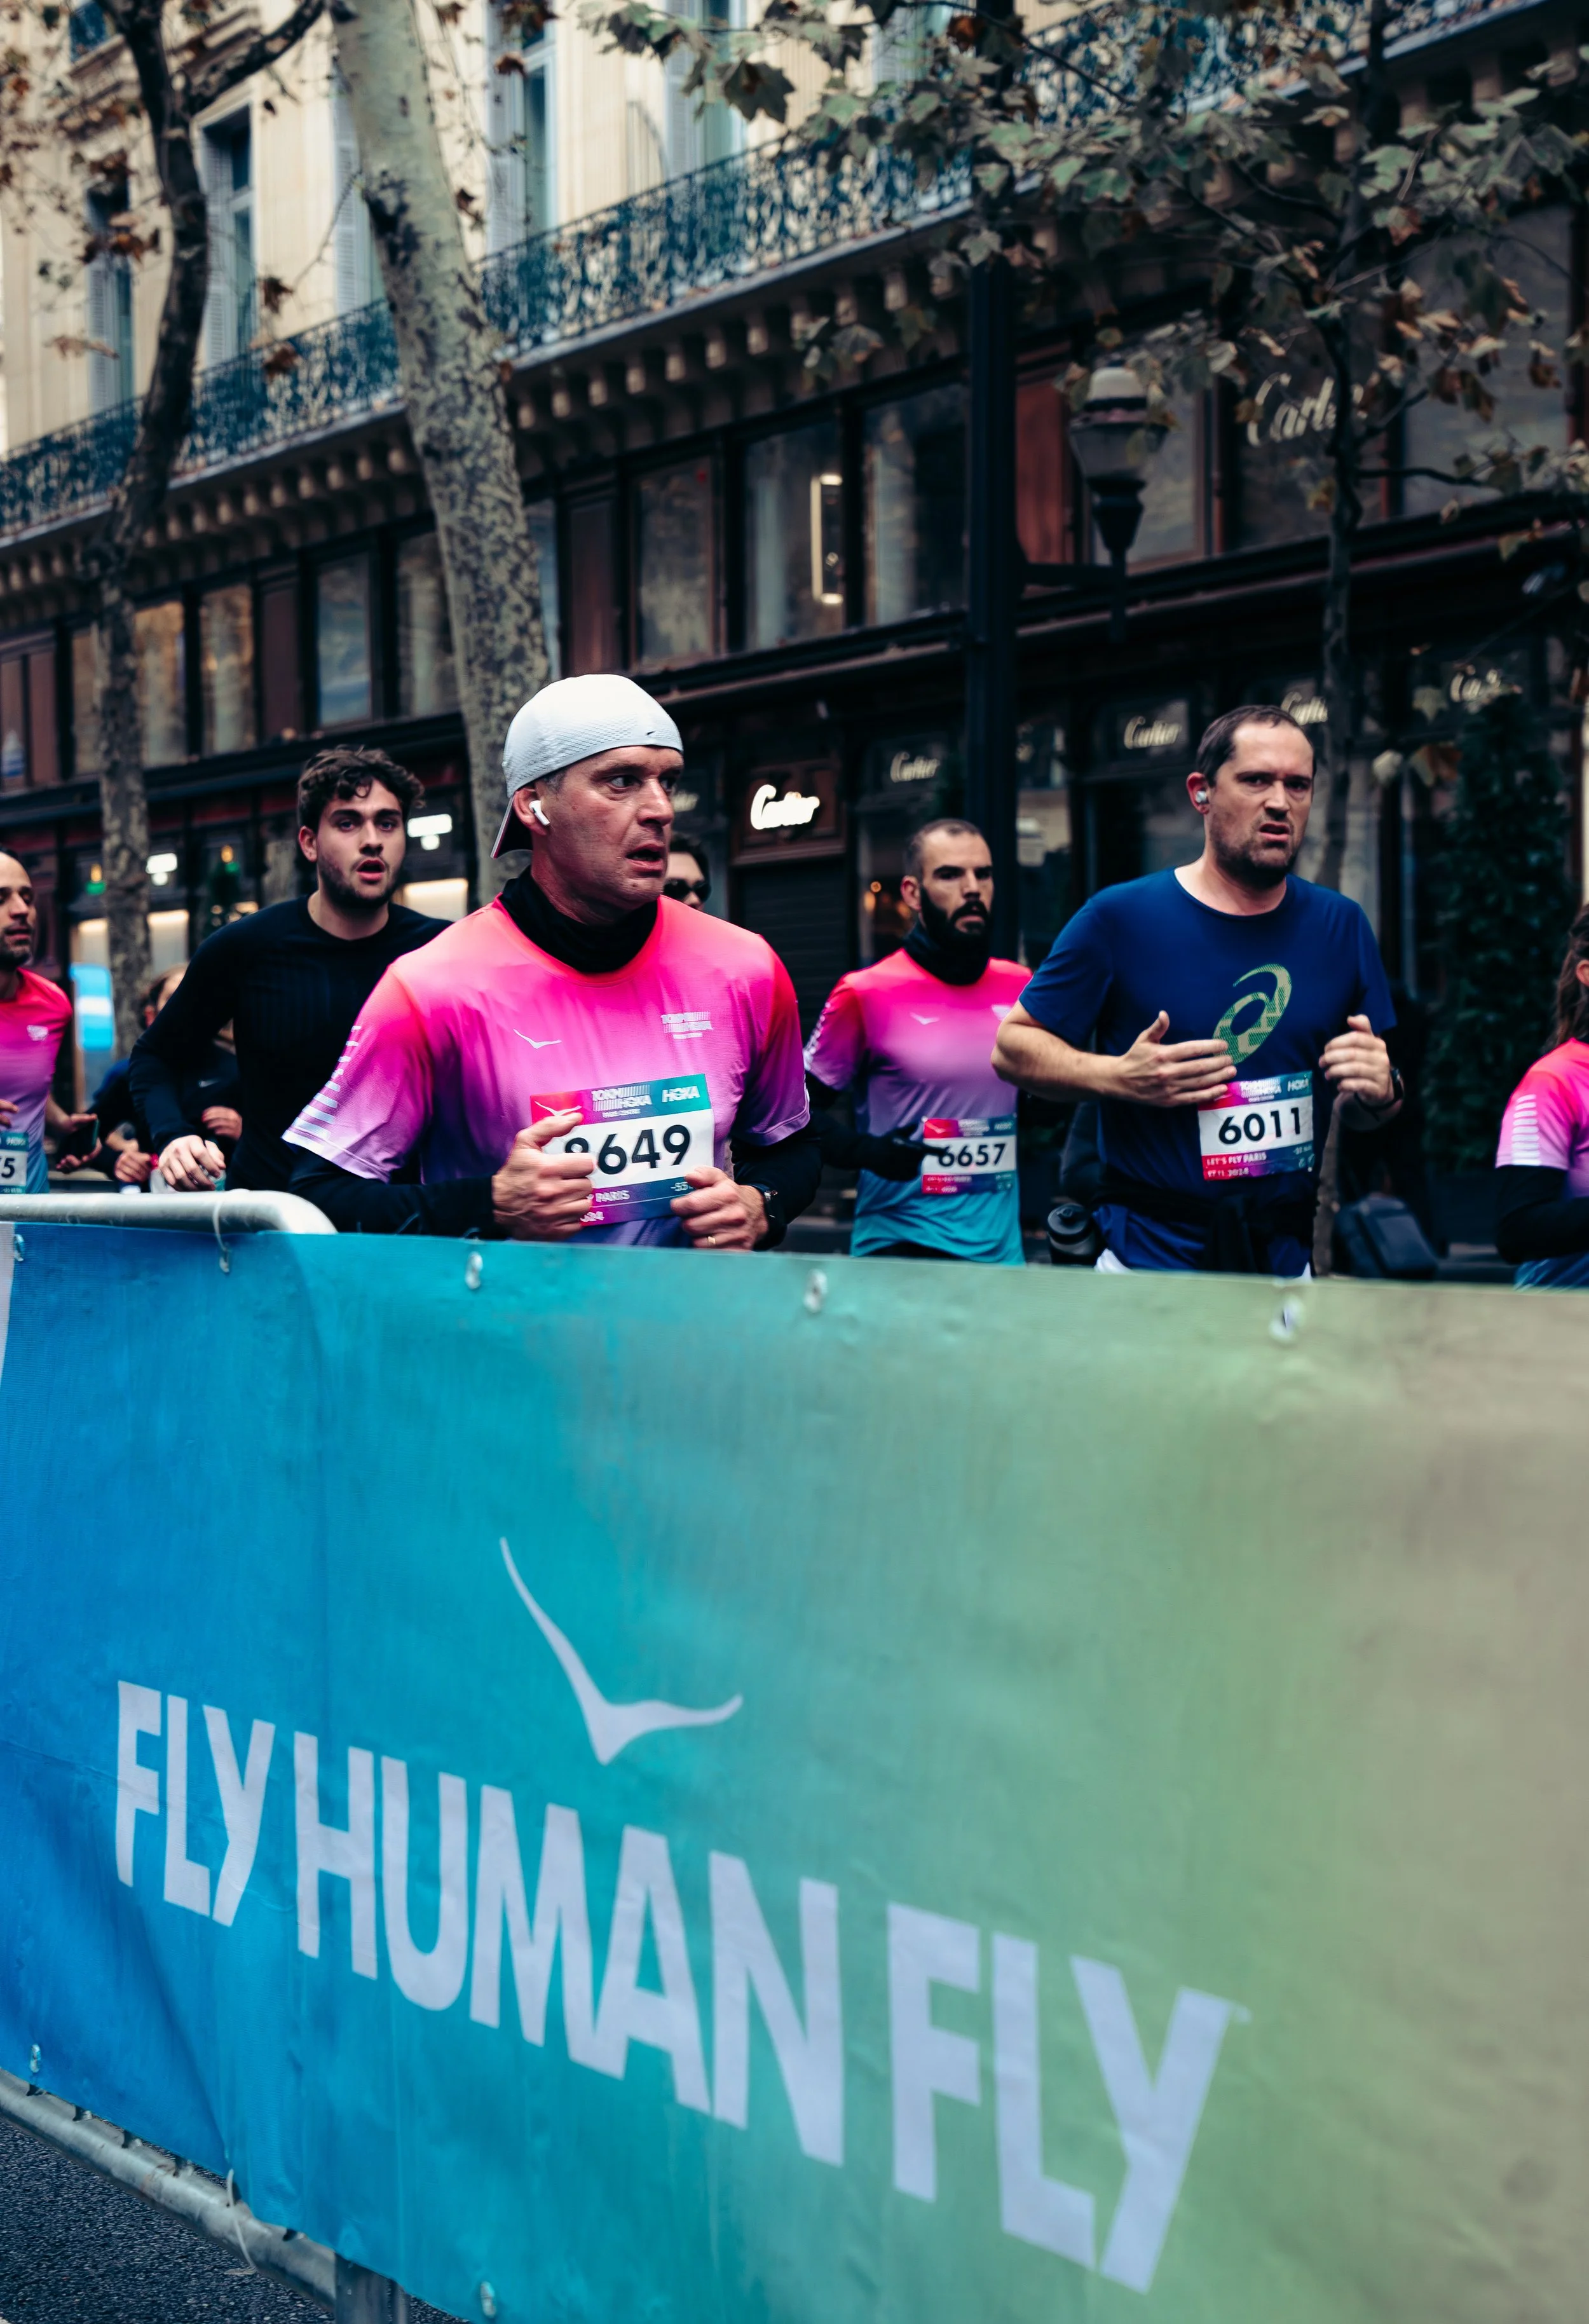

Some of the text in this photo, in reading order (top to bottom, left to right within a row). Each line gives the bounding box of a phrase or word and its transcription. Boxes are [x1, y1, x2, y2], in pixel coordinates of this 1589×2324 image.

[662, 1085, 700, 1103] HOKA
[1218, 1107, 1300, 1145] 6011
[938, 1143, 1006, 1167] 6657
[1243, 1151, 1267, 1163] PARIS
[596, 1189, 630, 1203] PARIS
[116, 1682, 1231, 2295] FLY HUMAN FLY
